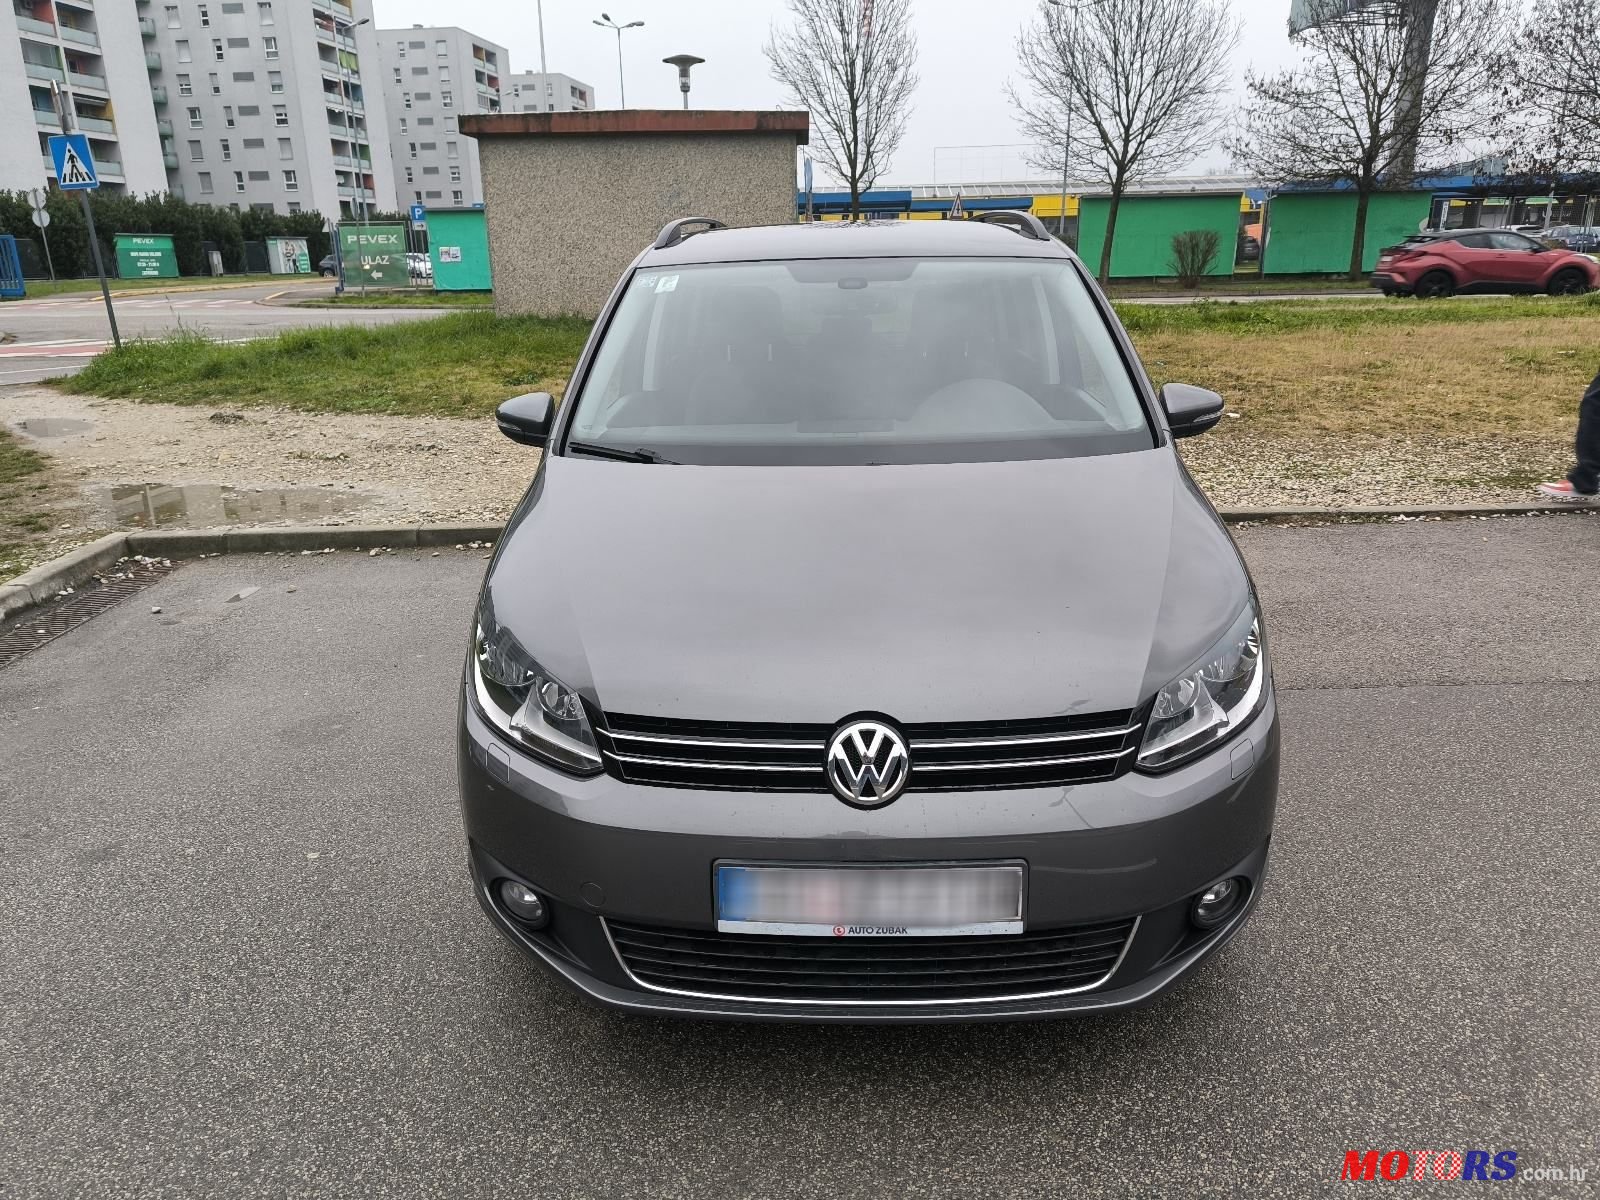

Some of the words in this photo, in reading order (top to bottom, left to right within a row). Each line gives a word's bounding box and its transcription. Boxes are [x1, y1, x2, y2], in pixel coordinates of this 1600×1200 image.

[414, 208, 422, 219] P
[347, 234, 398, 245] PEVEX
[361, 255, 390, 265] ULAZ
[848, 926, 874, 935] AUTO
[875, 926, 907, 935] ZUBAK
